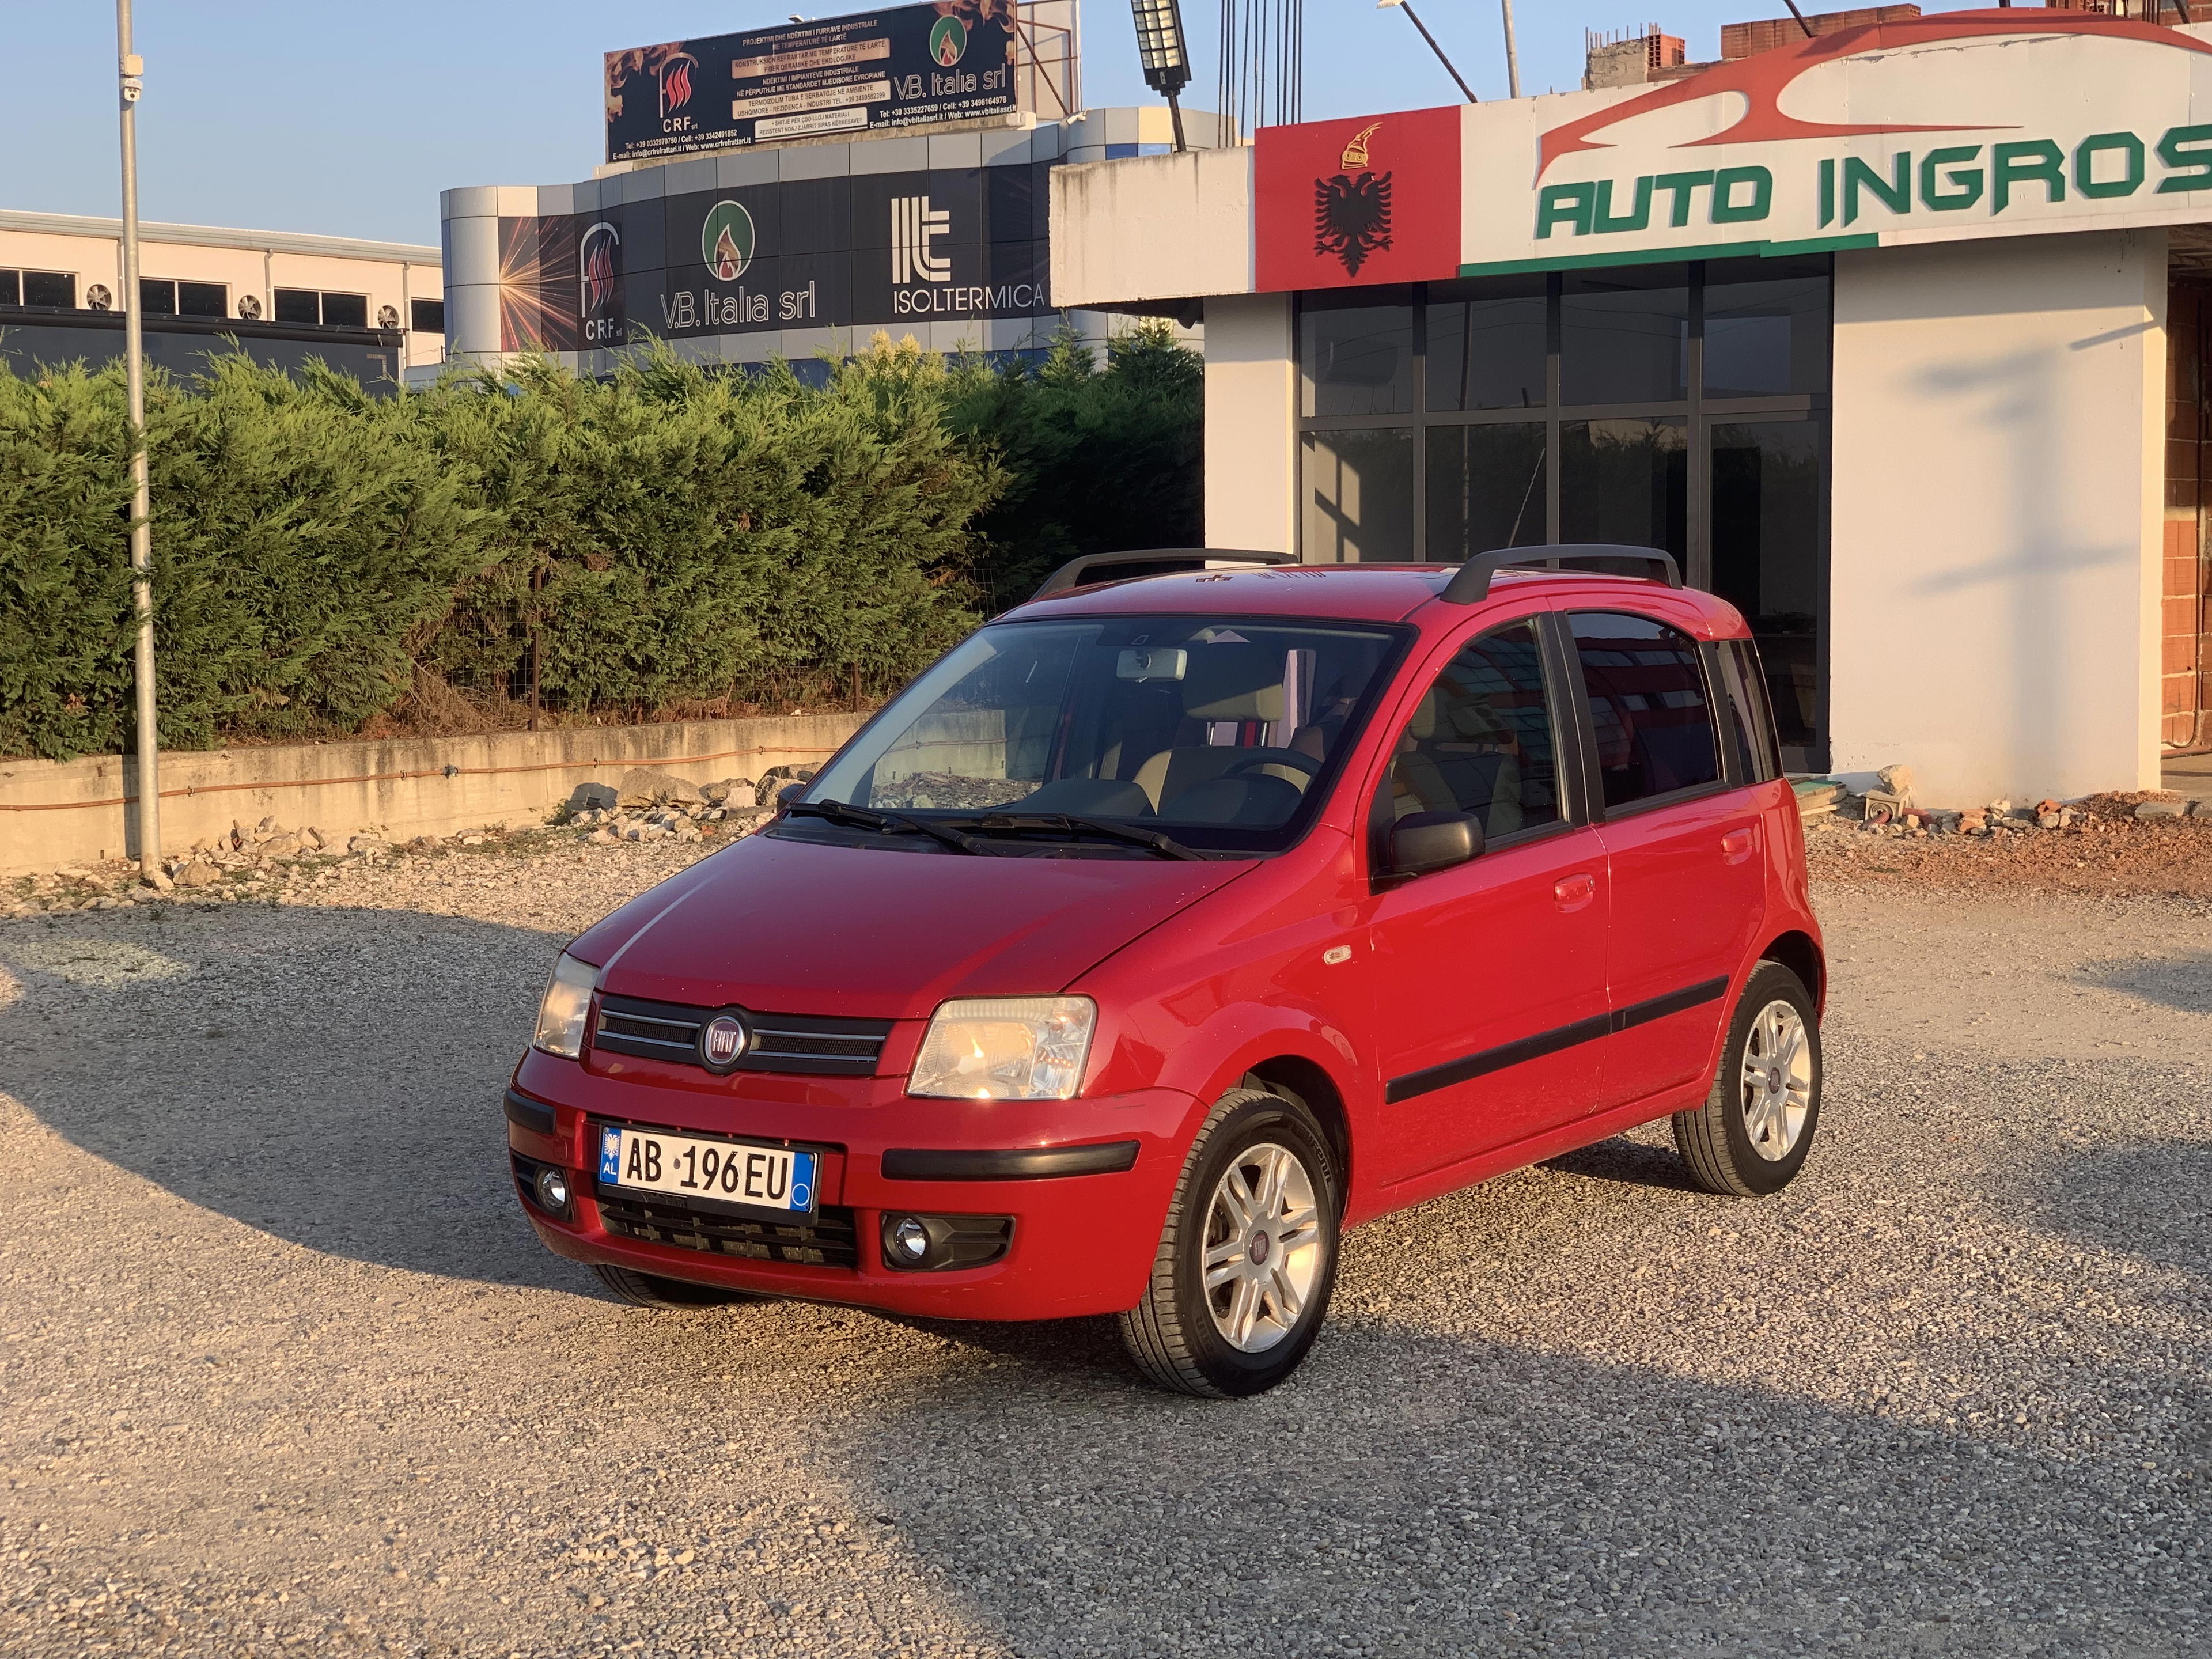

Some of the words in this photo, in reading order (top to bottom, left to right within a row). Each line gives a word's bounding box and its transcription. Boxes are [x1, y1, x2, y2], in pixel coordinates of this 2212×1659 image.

[743, 36, 774, 46] PROJEKTIMI
[775, 33, 786, 41] DHE
[787, 29, 812, 39] NDËRTIMI
[816, 25, 840, 35] FURRAVE
[842, 20, 878, 31] INDUSTRIALE
[734, 58, 775, 68] KONSTRUKSION
[777, 52, 808, 62] REFRAKTAR
[781, 60, 808, 70] QERAMIKE
[821, 54, 856, 65] EKOLOGJIKE
[763, 75, 787, 85] NDËRTIMI
[791, 71, 823, 81] IMPIANTEVE
[824, 66, 859, 77] INDUSTRIALE
[786, 81, 822, 90] STANDARDET
[822, 75, 853, 85] MJEDISORE
[854, 70, 885, 81] EVROPIANE
[931, 69, 977, 96] Italia
[983, 63, 1005, 90] srl
[749, 97, 783, 107] TERMOIZOLIM
[785, 94, 800, 102] TUBA
[805, 89, 836, 100] SERBATOJE
[846, 85, 874, 94] AMBIENTE
[737, 107, 769, 117] USHQIMORE
[773, 104, 802, 112] REZIDENCA
[806, 99, 831, 108] INDUSTRI
[825, 111, 850, 119] MATERIALI
[880, 110, 890, 118] Tel:
[903, 104, 938, 115] 3335227659
[942, 102, 956, 110] Cell:
[971, 96, 1007, 107] 3496164978
[663, 116, 691, 133] CRF
[870, 119, 891, 128] E-mail:
[892, 113, 944, 126] info@vbitaliasrl.it
[948, 111, 964, 119] Web:
[613, 151, 631, 160] E-mail:
[700, 137, 751, 149] www.crfrefrattari.it
[646, 137, 677, 147] 0332970750
[681, 135, 694, 143] Cell:
[705, 129, 737, 140] 3342491852
[1533, 165, 1773, 240] AUTO
[1817, 124, 2212, 229] INGROS
[704, 286, 769, 325] Italia
[779, 280, 815, 320] srl
[893, 283, 1045, 314] ISOLTERMICA
[585, 317, 614, 340] CRF
[713, 1029, 737, 1053] FIAT
[603, 1162, 618, 1175] AL
[627, 1138, 662, 1182] AB
[1255, 1238, 1267, 1256] FIAT
